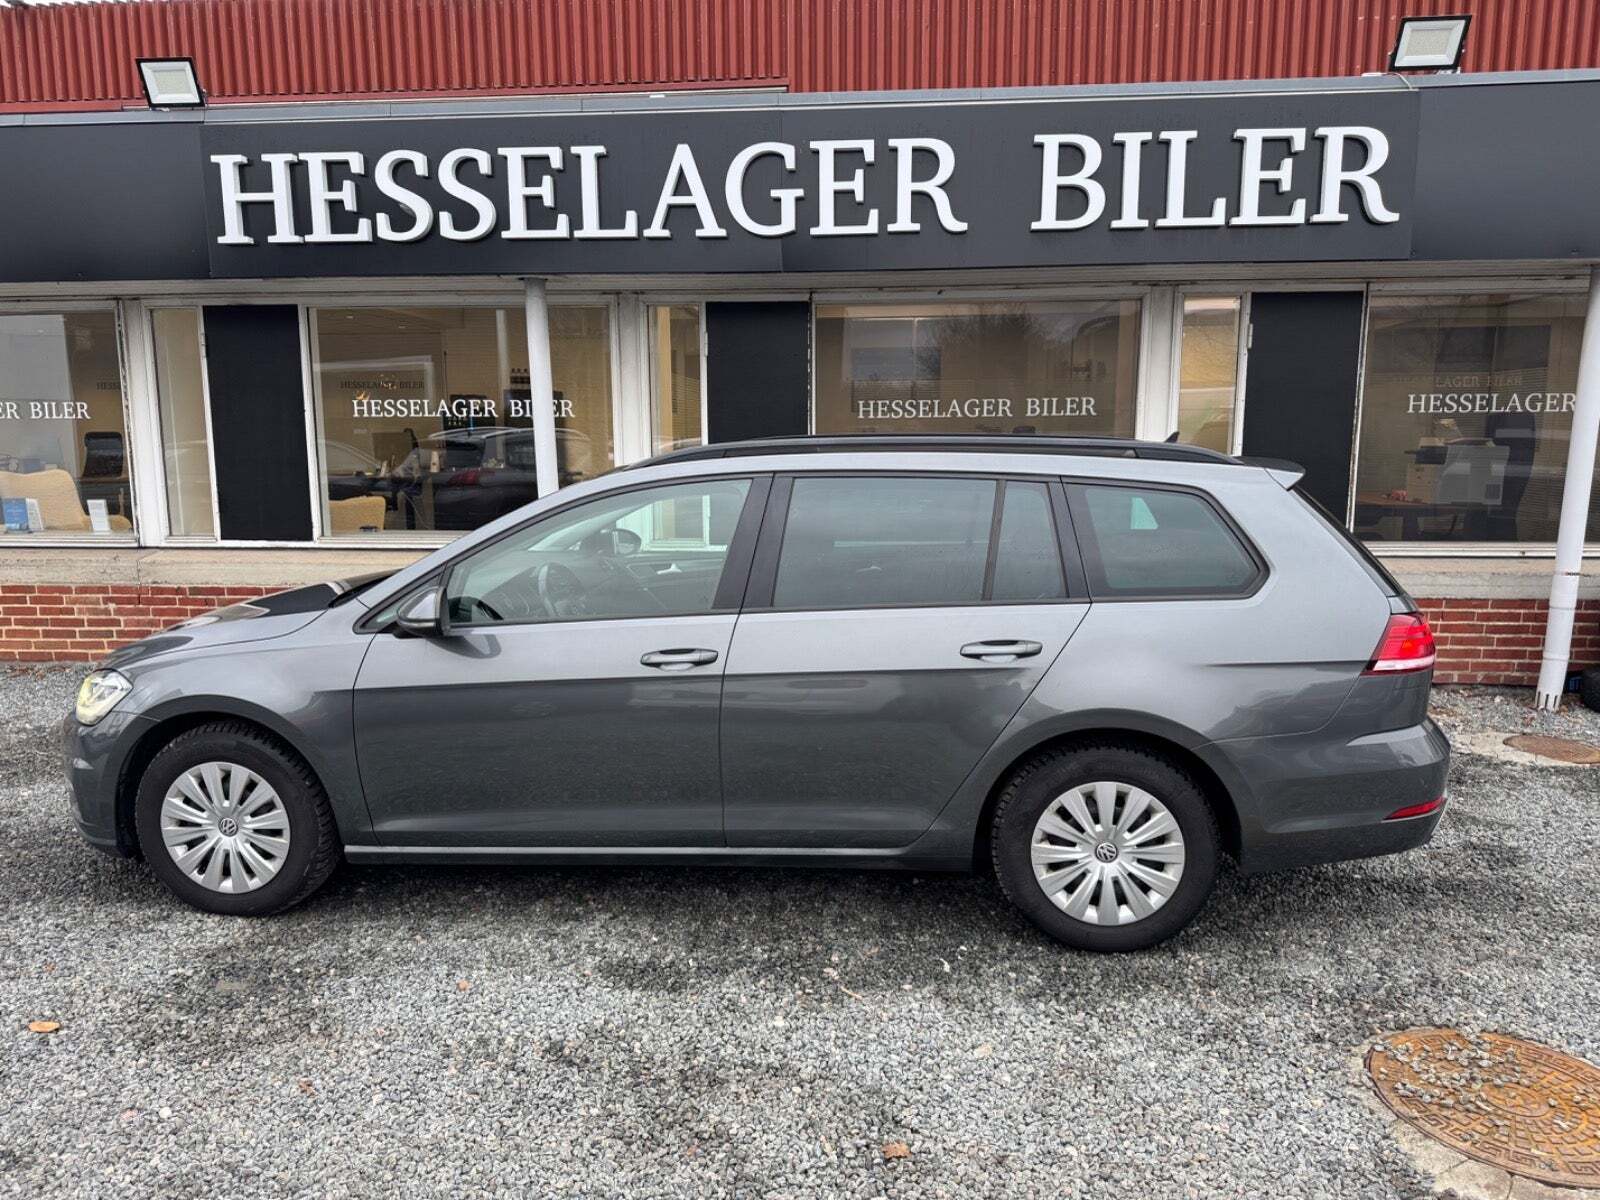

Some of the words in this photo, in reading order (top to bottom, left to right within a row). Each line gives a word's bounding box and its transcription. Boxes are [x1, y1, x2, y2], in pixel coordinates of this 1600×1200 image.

[209, 137, 969, 245] HESSELAGER
[1029, 125, 1400, 231] BILER
[29, 401, 91, 419] BILER
[352, 399, 498, 419] HESSELAGER
[510, 399, 576, 418] BIER
[857, 398, 1013, 419] HESSELAGER
[1025, 397, 1097, 417] BILER
[1407, 392, 1576, 413] HESSELAGER
